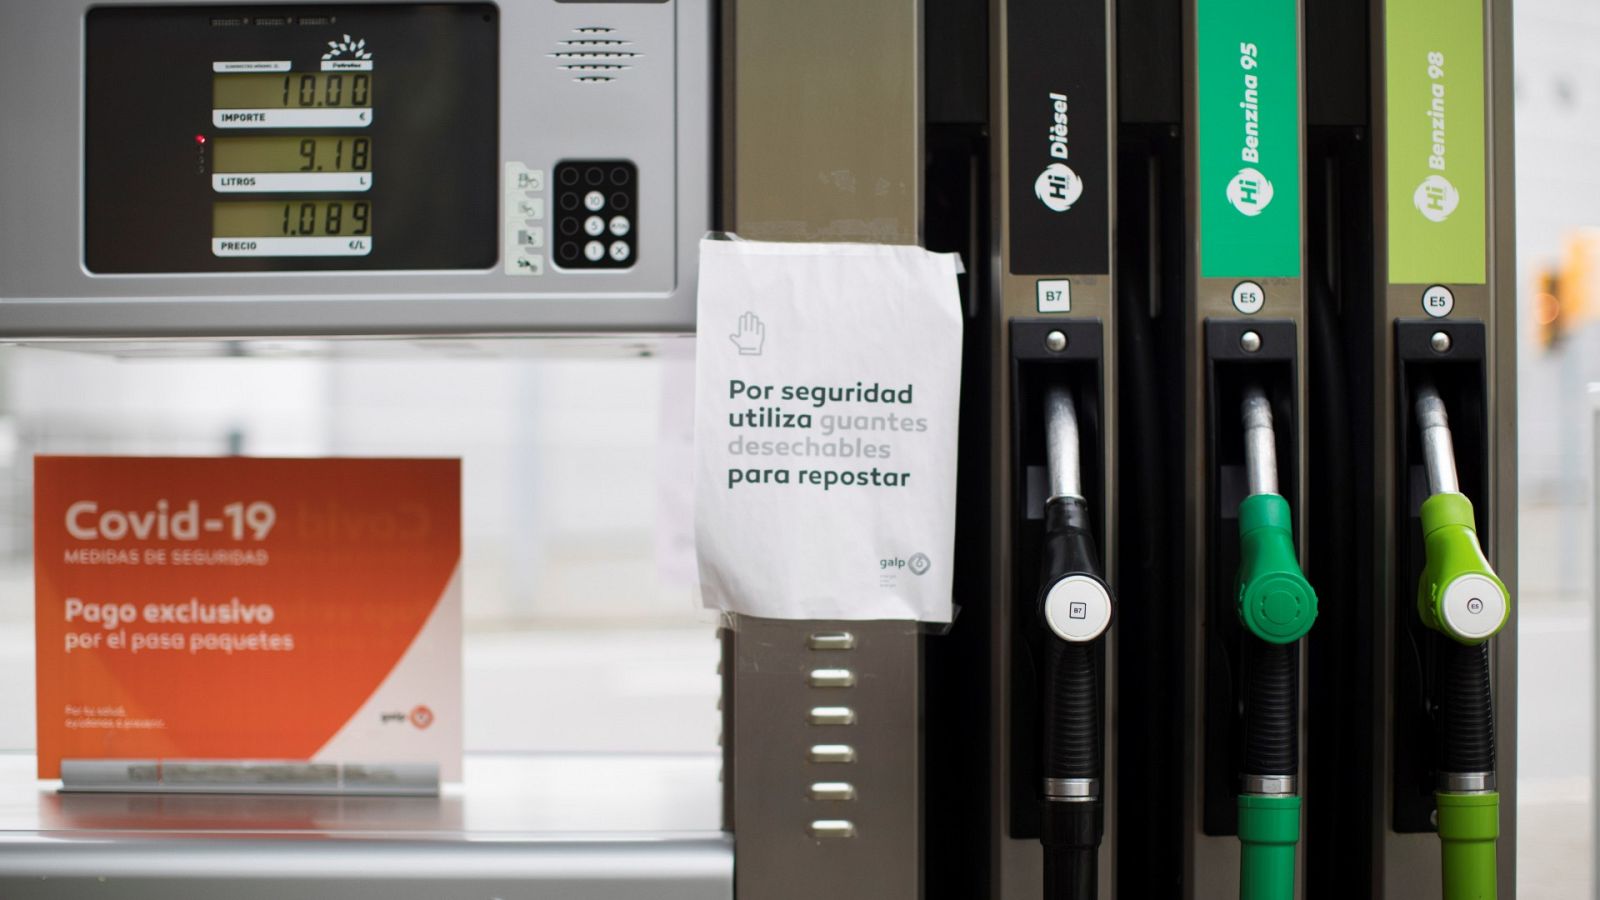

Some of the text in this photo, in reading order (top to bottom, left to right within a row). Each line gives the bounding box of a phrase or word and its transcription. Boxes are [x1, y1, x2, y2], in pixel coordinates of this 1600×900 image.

[283, 74, 369, 107] 10.00
[221, 113, 266, 122] IMPORTE
[359, 112, 366, 121] €
[1238, 42, 1259, 205] Hi Benzina 95
[1425, 51, 1446, 211] Hi Benzina 98
[300, 139, 369, 171] 9.18
[221, 177, 256, 186] LITROS
[360, 176, 366, 185] L
[1047, 174, 1066, 200] Hi
[589, 196, 601, 206] 10
[282, 203, 369, 235] 1.089
[221, 241, 257, 250] PRECIO
[349, 240, 366, 250] €/L
[1045, 291, 1062, 302] B7
[1240, 292, 1256, 304] E5
[1430, 296, 1446, 307] E5
[729, 379, 913, 408] Por seguridad
[729, 407, 928, 436] utiliza guantes
[728, 435, 891, 459] desechables
[728, 468, 910, 490] para repostar
[64, 499, 276, 541] Covid-19
[64, 550, 269, 566] MEDIDAS DE SEGURIDAD
[879, 556, 906, 570] galp
[64, 598, 137, 630] Pago
[143, 597, 275, 624] exclusivo
[64, 629, 295, 655] por el pasa paquetes
